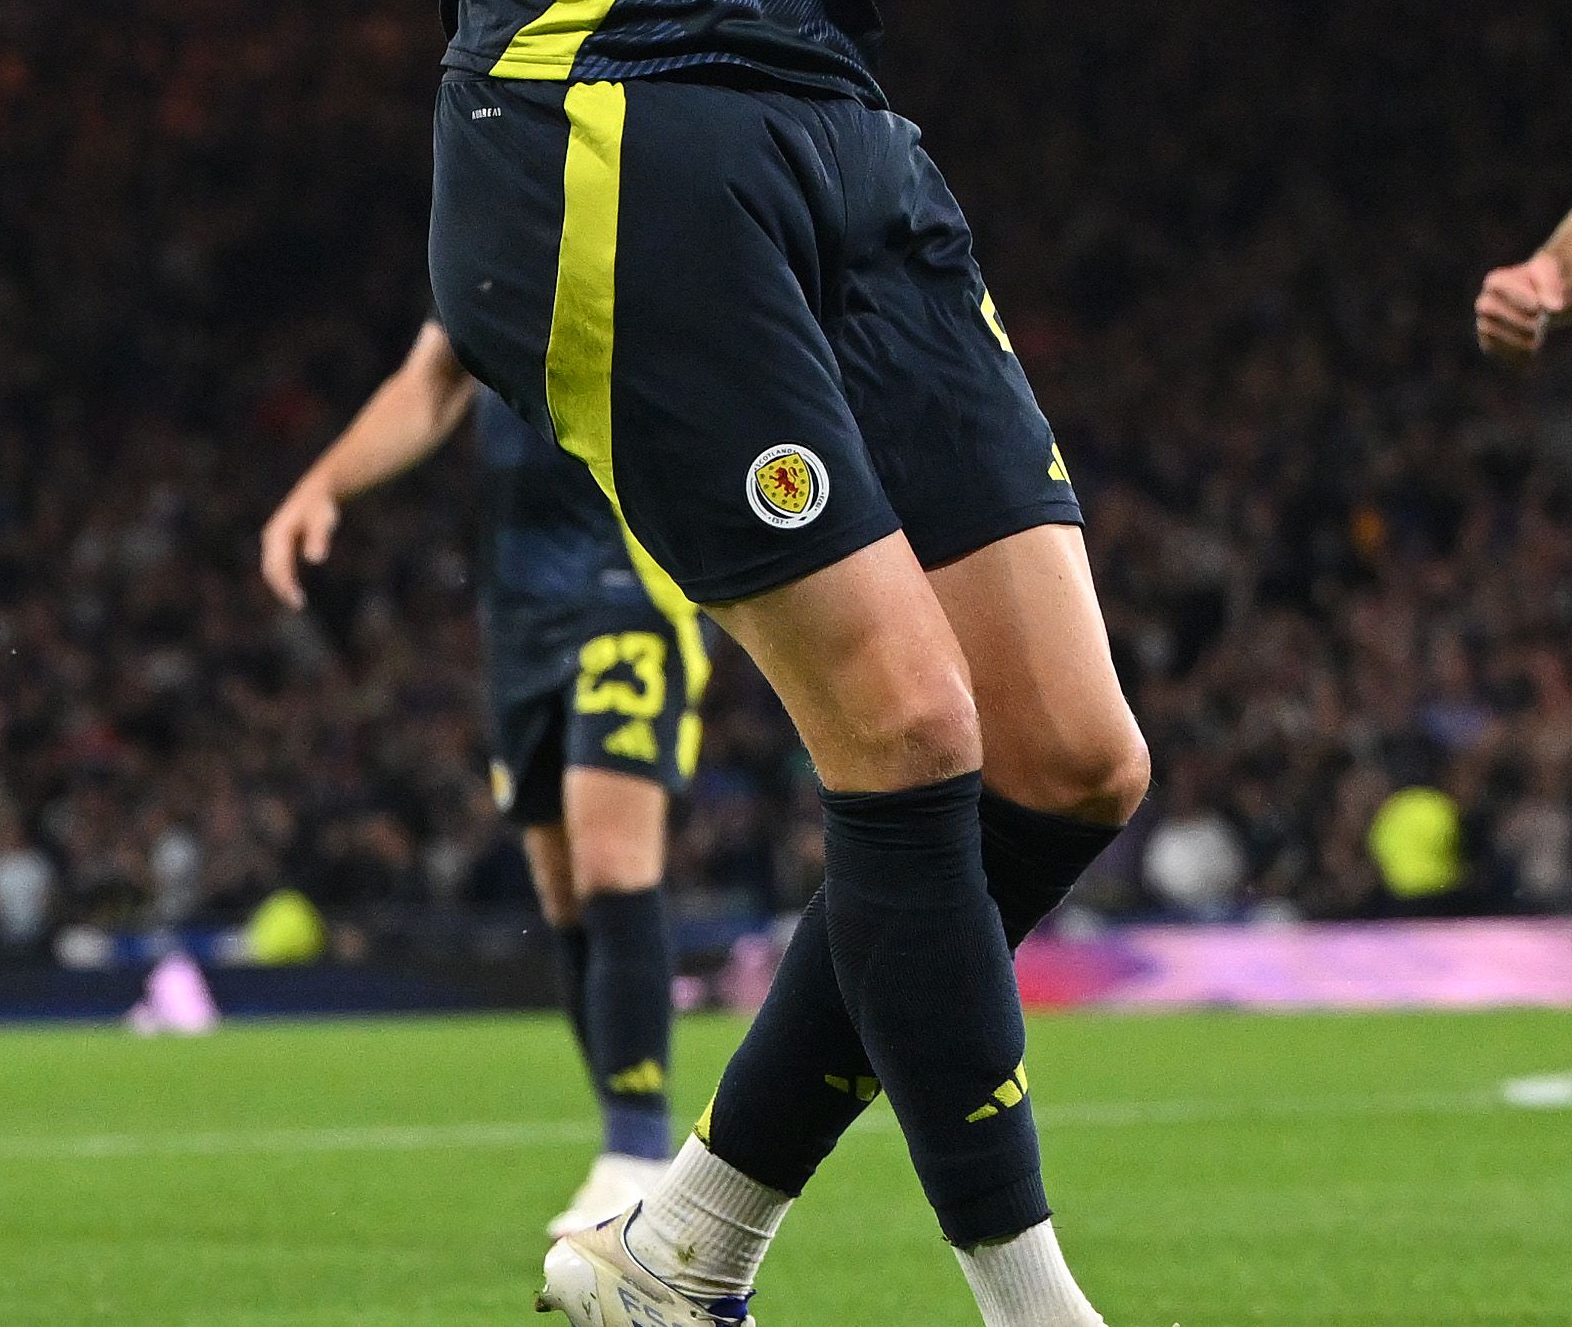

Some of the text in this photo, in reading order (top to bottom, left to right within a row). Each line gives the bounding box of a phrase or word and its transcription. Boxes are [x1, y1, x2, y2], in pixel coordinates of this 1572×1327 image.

[756, 448, 792, 468] SCOTLAND
[771, 516, 784, 524] EST
[574, 631, 667, 719] 23
